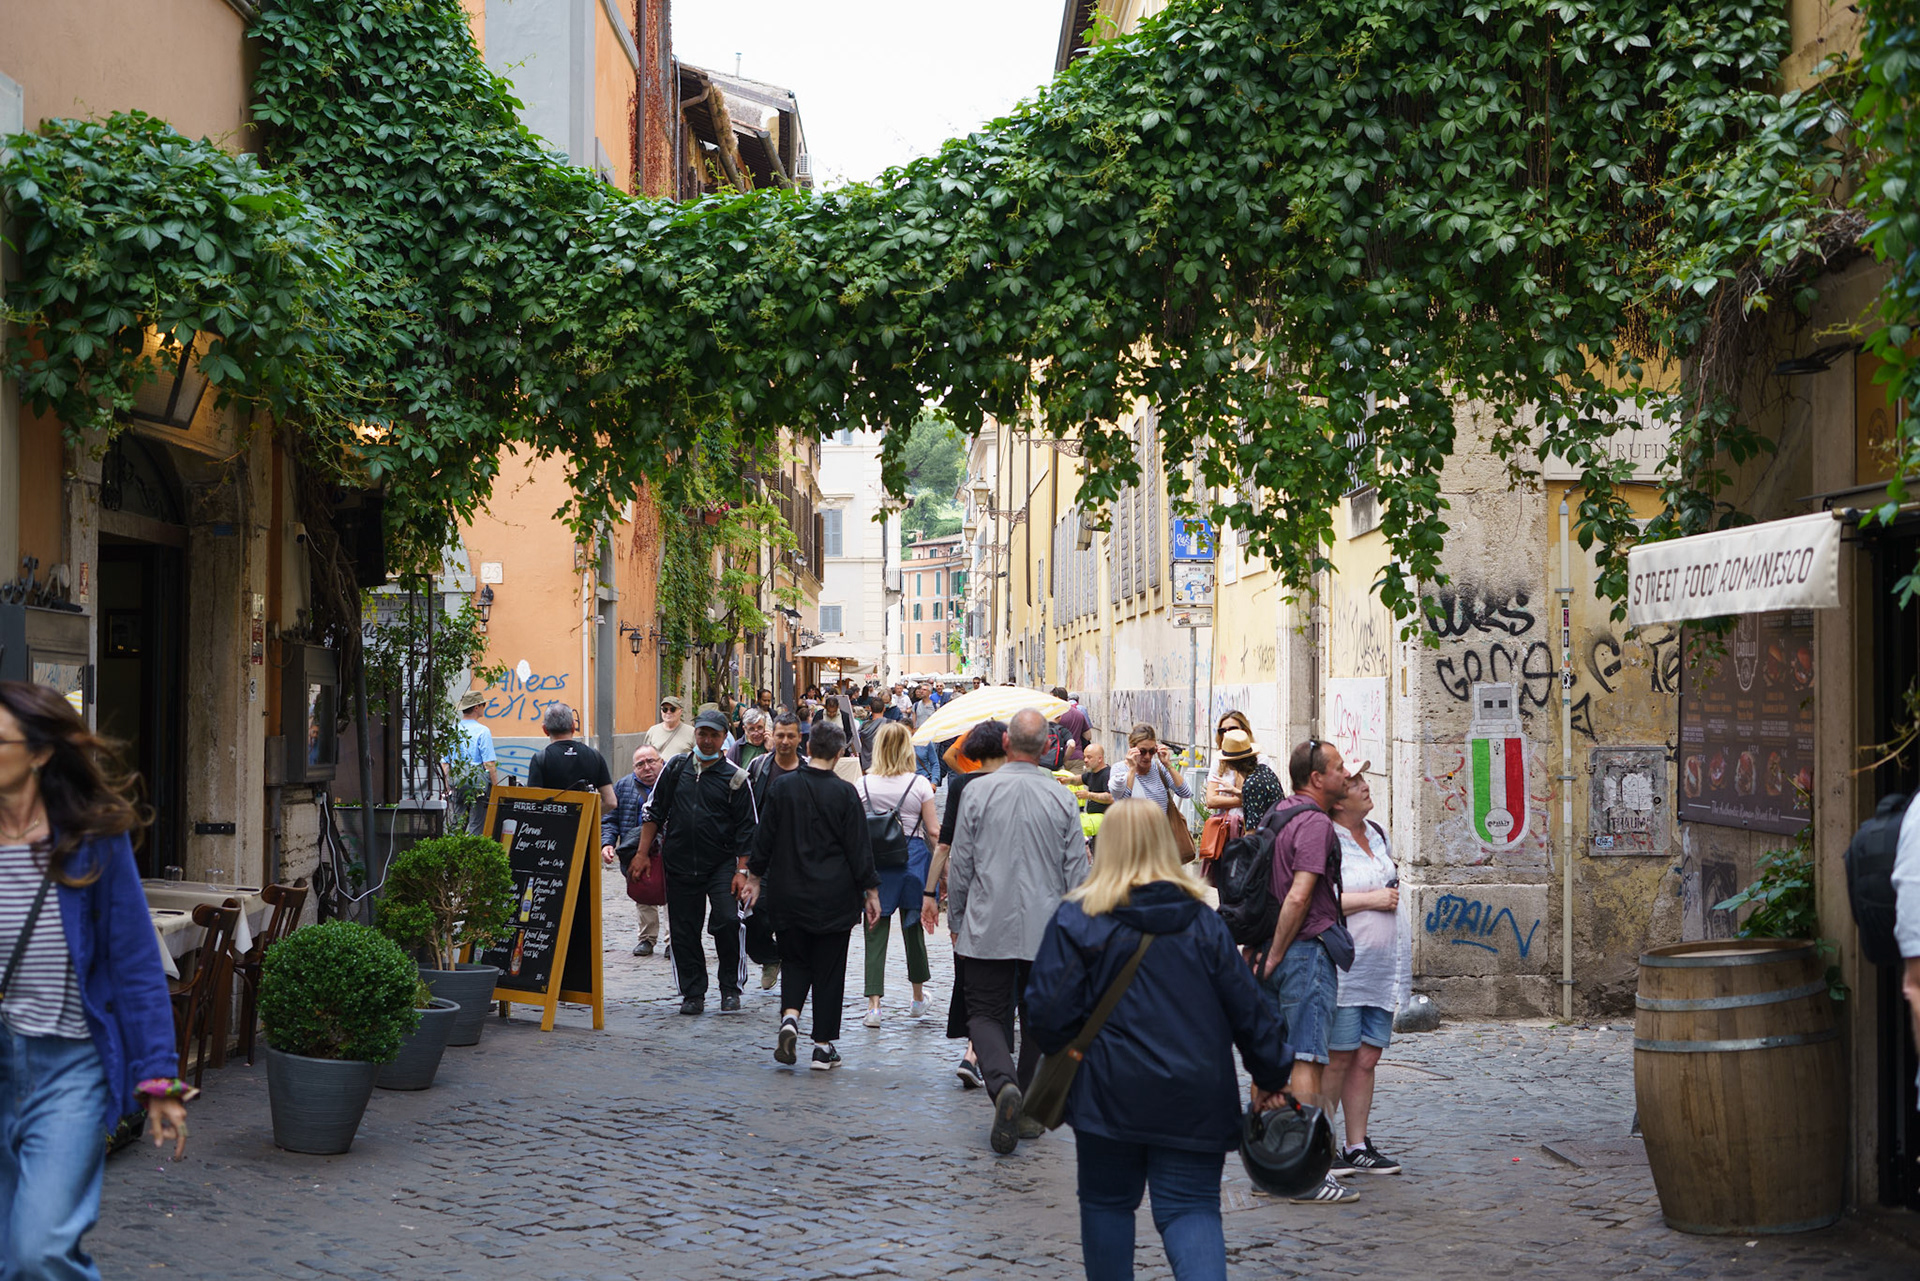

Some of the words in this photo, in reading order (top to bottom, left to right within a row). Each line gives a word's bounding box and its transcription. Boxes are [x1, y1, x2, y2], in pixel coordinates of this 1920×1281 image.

[1633, 567, 1679, 605] STREET
[1682, 562, 1719, 599] FOOD
[1718, 547, 1814, 593] ROMANESCO
[513, 801, 536, 811] BIRRE
[543, 804, 567, 813] BEERS
[517, 822, 542, 837] Peroni
